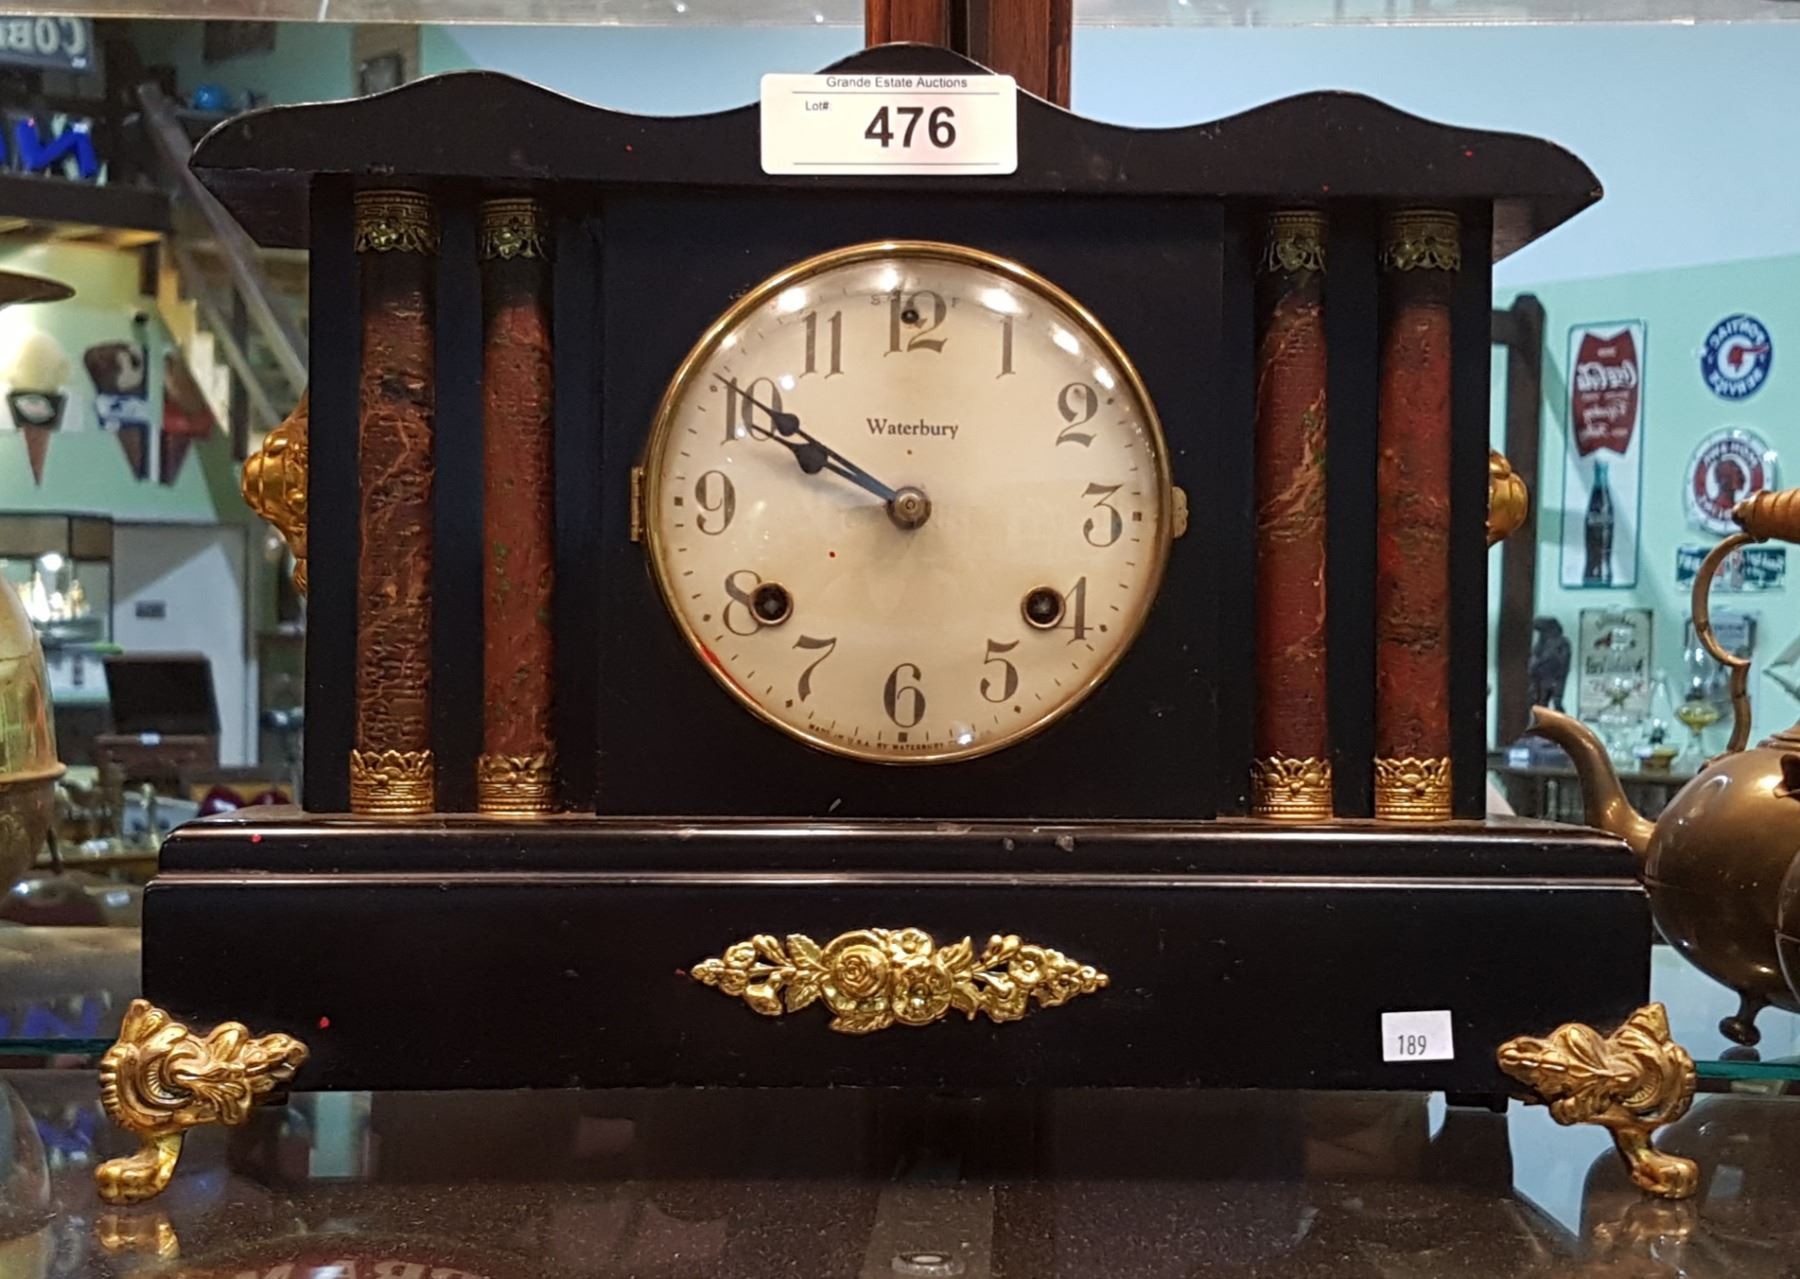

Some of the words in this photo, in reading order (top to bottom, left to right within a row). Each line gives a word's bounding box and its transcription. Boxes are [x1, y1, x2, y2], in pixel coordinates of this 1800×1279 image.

[826, 76, 871, 88] Grande
[875, 76, 913, 88] Estate
[916, 76, 968, 88] Auctions
[864, 106, 957, 149] 476
[800, 310, 844, 379] 11
[883, 288, 949, 357] 12
[996, 314, 1017, 379] 1
[720, 375, 783, 445] 10
[866, 418, 959, 440] Waterbury
[1055, 382, 1101, 447] 2
[694, 470, 736, 535] 9
[1082, 482, 1124, 548] 3
[722, 570, 766, 637] 8
[1058, 576, 1095, 646] 4
[792, 635, 838, 703] 7
[883, 663, 926, 729] 6
[979, 639, 1021, 704] 5
[1398, 1035, 1427, 1055] 189
